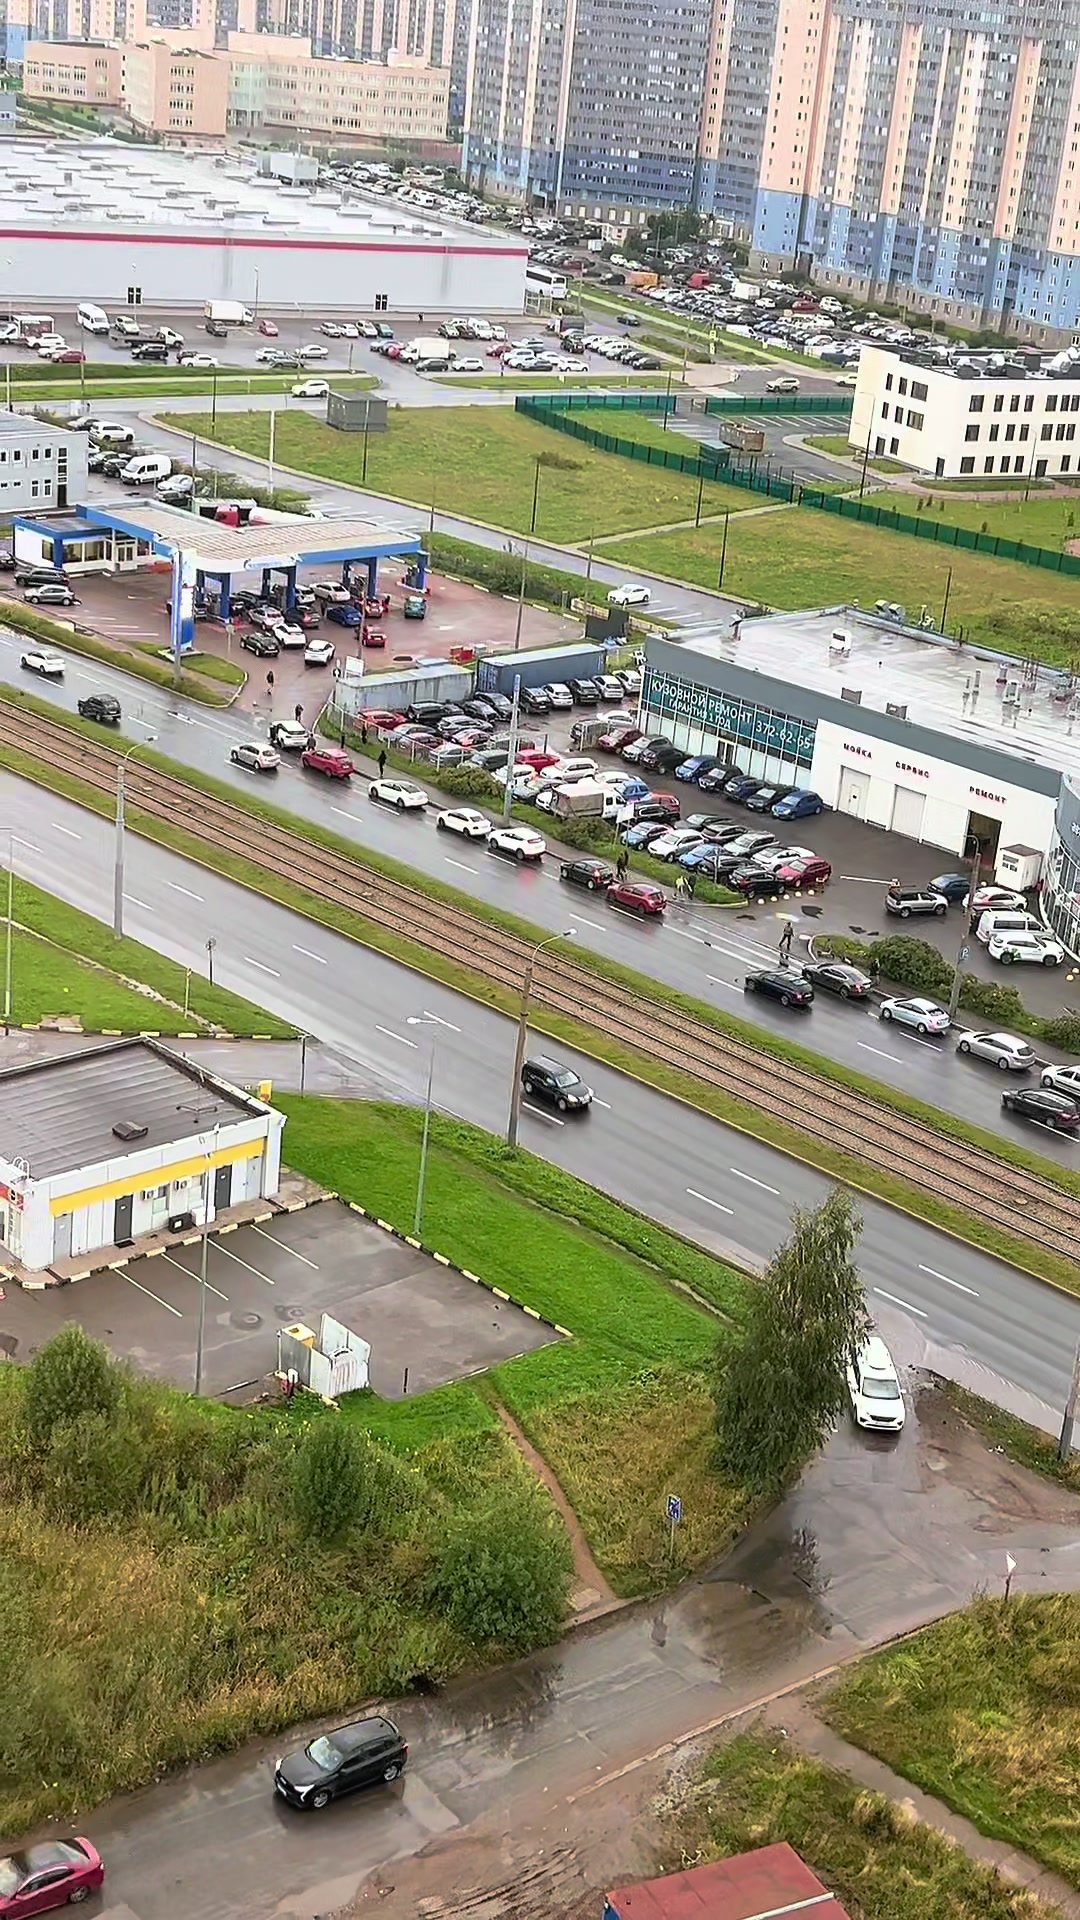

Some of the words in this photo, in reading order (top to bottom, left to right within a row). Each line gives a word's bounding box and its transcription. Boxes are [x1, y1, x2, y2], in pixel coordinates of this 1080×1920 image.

[652, 679, 705, 707] КУЗОВНОЙ
[709, 699, 752, 723] РЕМОНТ
[756, 720, 811, 749] 372-62-65
[843, 743, 872, 759] МОЙКА
[896, 761, 929, 778] СЕРВИС
[969, 786, 1007, 804] РЕМОНТ
